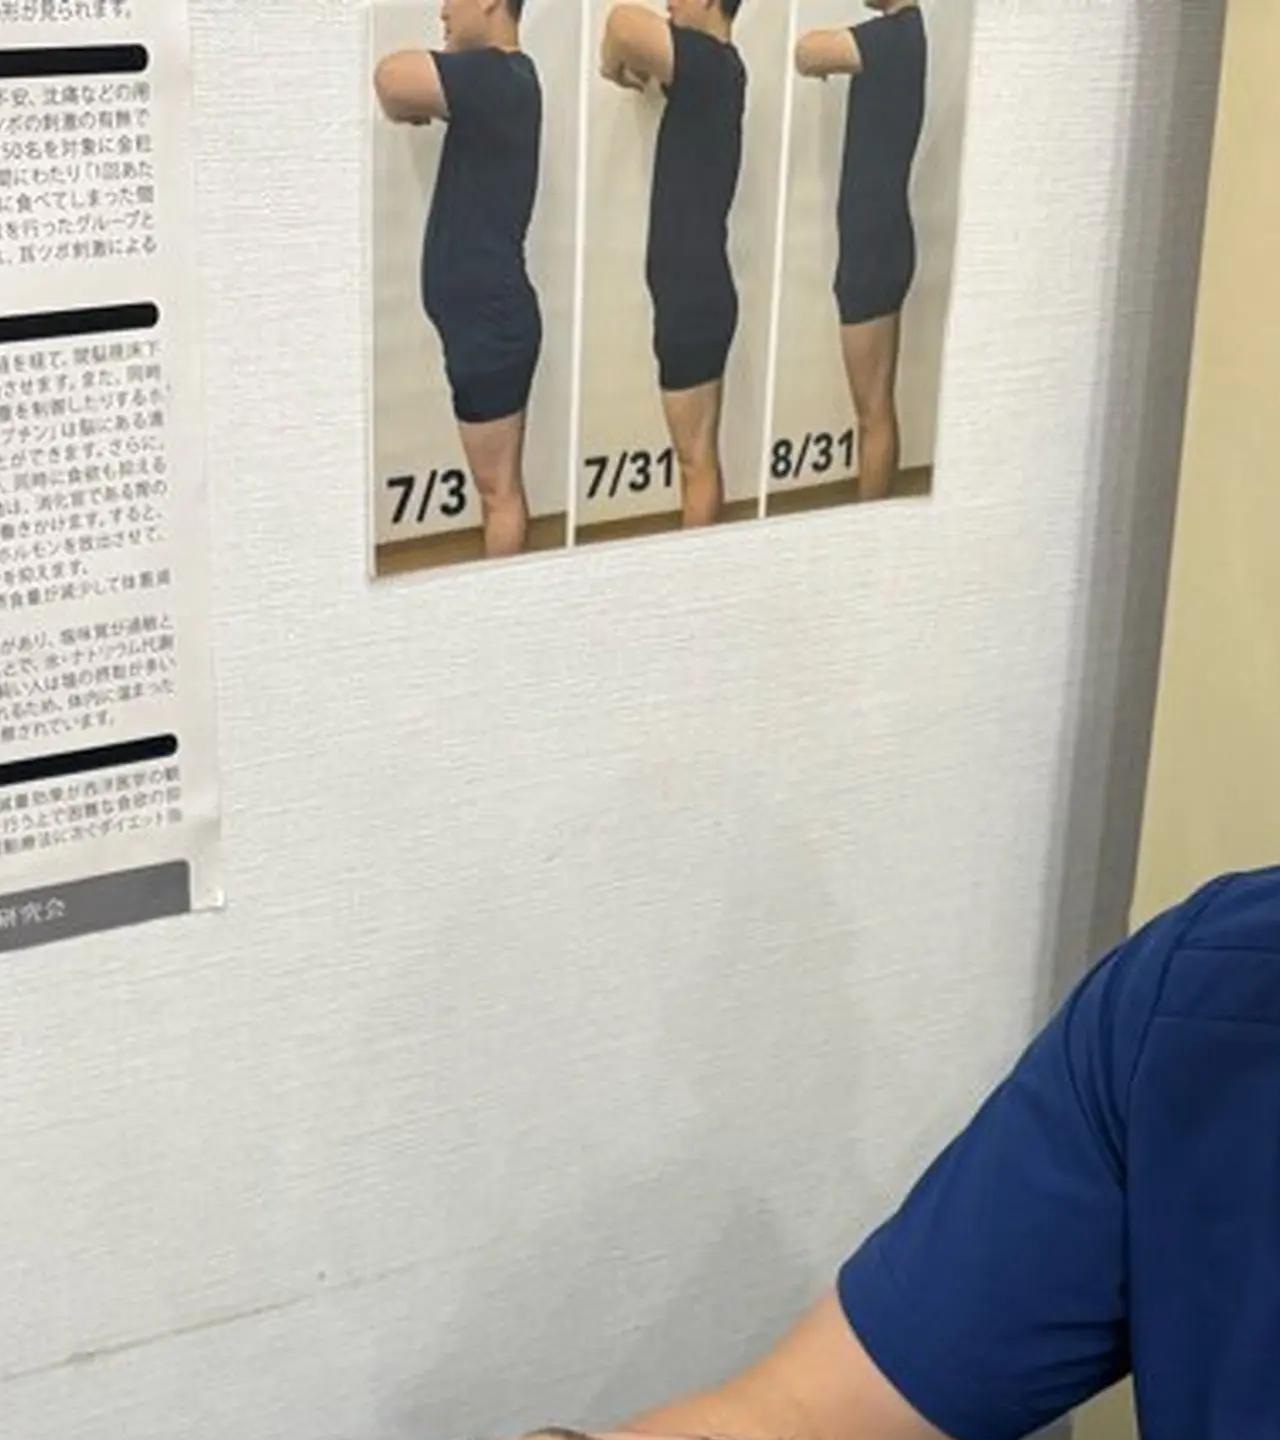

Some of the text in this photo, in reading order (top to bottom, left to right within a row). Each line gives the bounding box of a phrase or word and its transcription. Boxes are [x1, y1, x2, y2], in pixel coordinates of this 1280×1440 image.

[386, 429, 854, 524] 7/3 7/31 8/31
